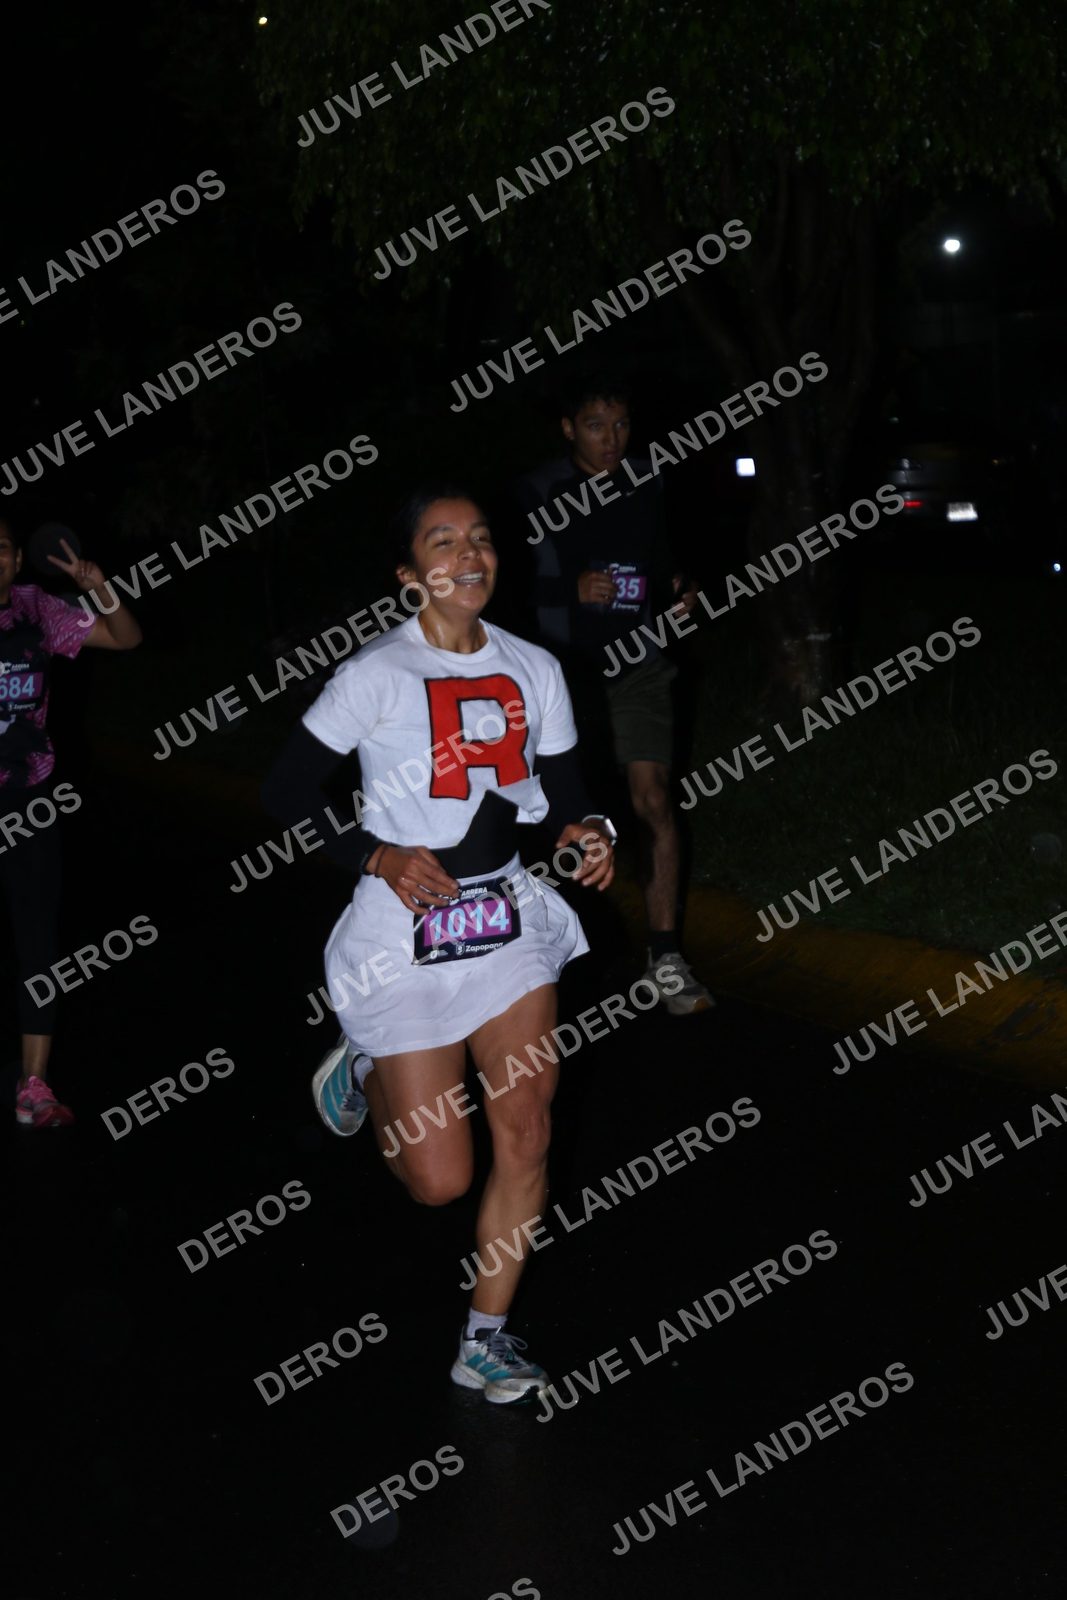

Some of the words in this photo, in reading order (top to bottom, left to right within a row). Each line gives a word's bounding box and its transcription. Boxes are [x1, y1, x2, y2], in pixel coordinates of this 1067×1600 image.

[612, 577, 641, 599] 35
[424, 672, 530, 801] R
[429, 900, 510, 941] 1014
